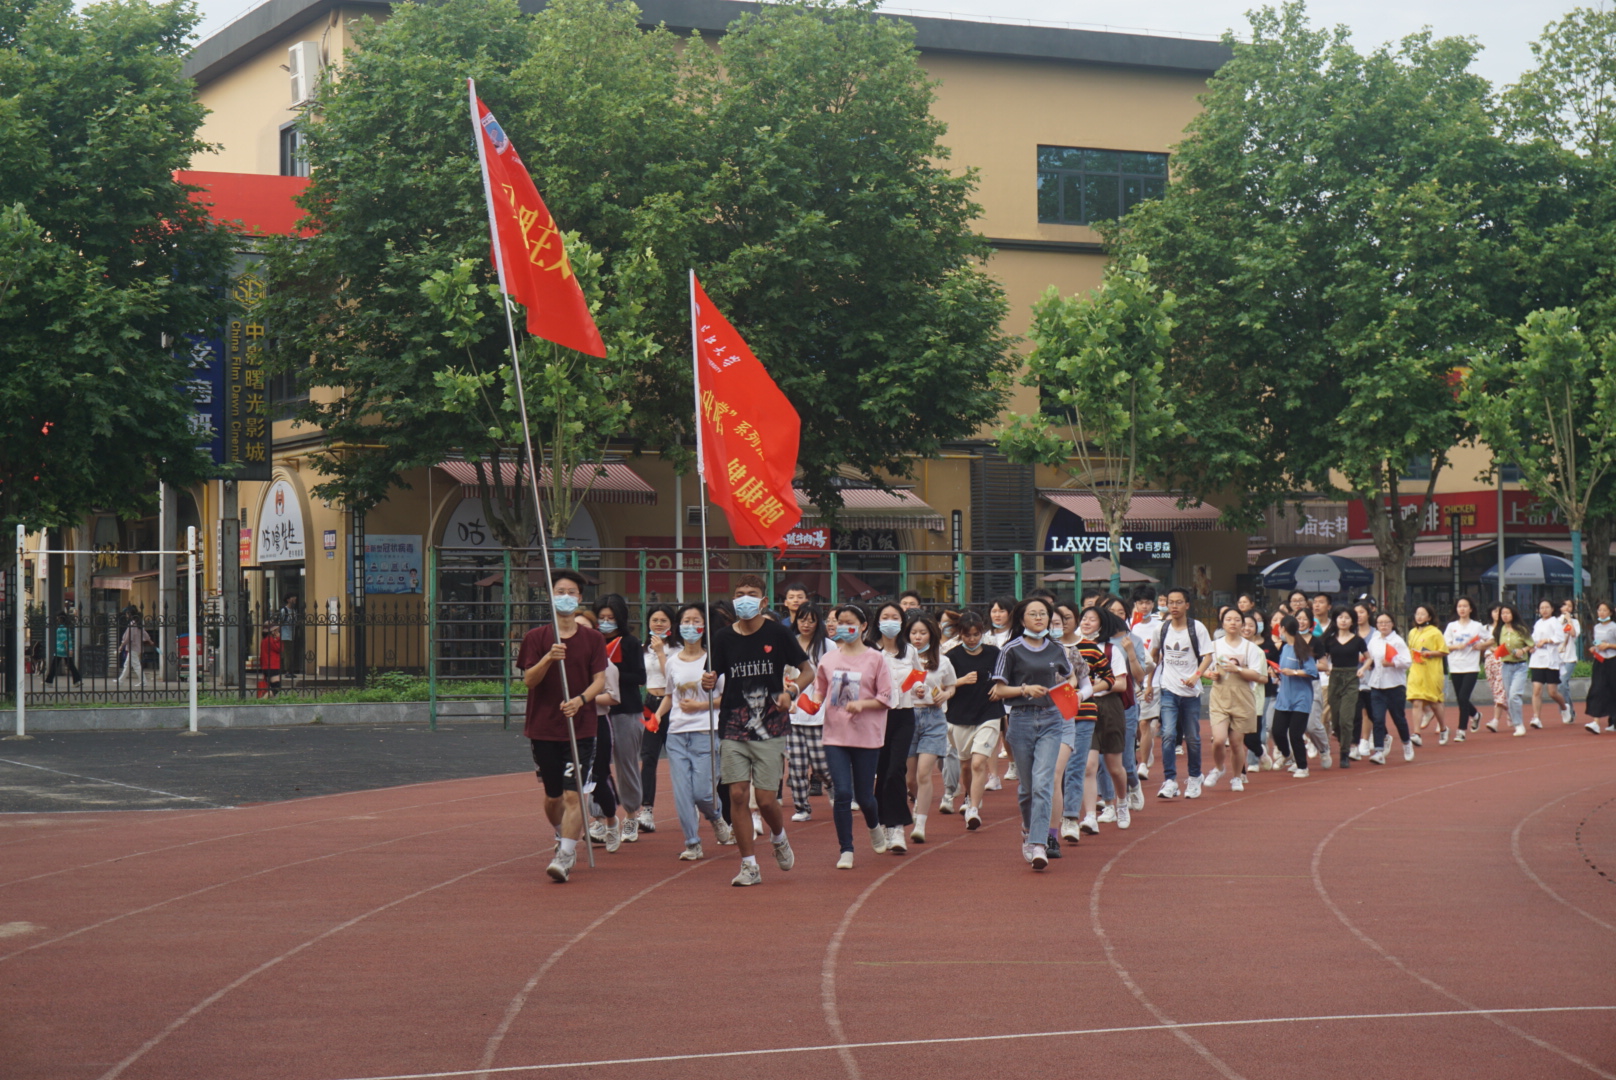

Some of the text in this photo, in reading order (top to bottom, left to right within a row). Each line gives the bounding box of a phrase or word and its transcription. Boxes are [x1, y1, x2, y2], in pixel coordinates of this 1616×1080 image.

[231, 320, 242, 462] China Film Dawn Cinema
[245, 321, 266, 462] 中影曙光影城
[728, 457, 785, 528] 健康跑
[1443, 504, 1476, 514] CHICKEN
[1051, 536, 1133, 552] LAWSN
[1135, 541, 1171, 552] 中百罗森
[1166, 658, 1189, 666] adidas
